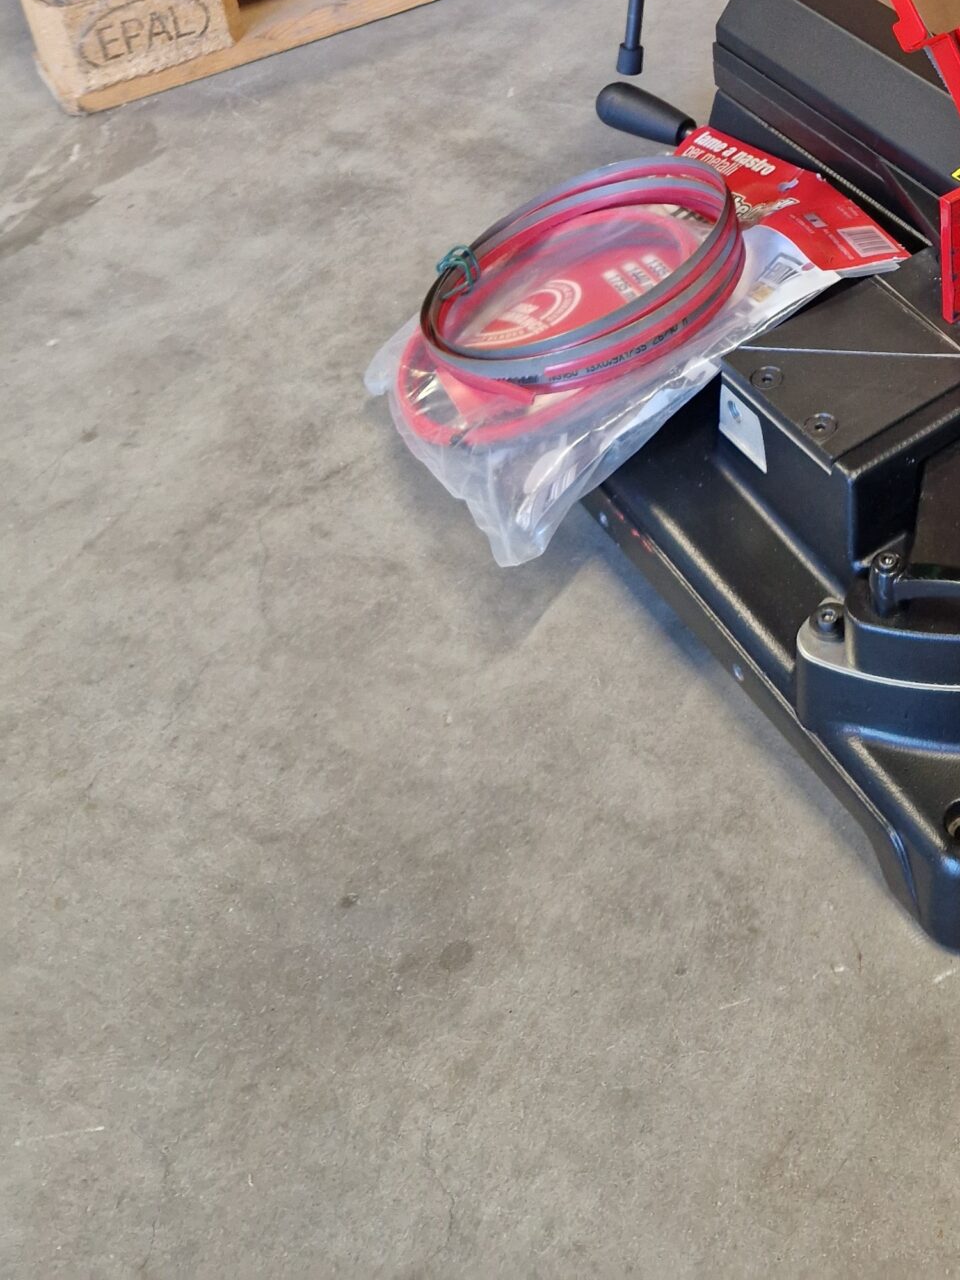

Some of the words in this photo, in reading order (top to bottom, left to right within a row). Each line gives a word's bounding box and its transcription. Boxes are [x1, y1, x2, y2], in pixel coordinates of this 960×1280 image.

[96, 5, 196, 61] EPAL
[682, 145, 704, 162] per
[702, 153, 741, 177] metalli
[693, 131, 728, 154] lame
[723, 145, 736, 159] a
[732, 150, 777, 177] nastro
